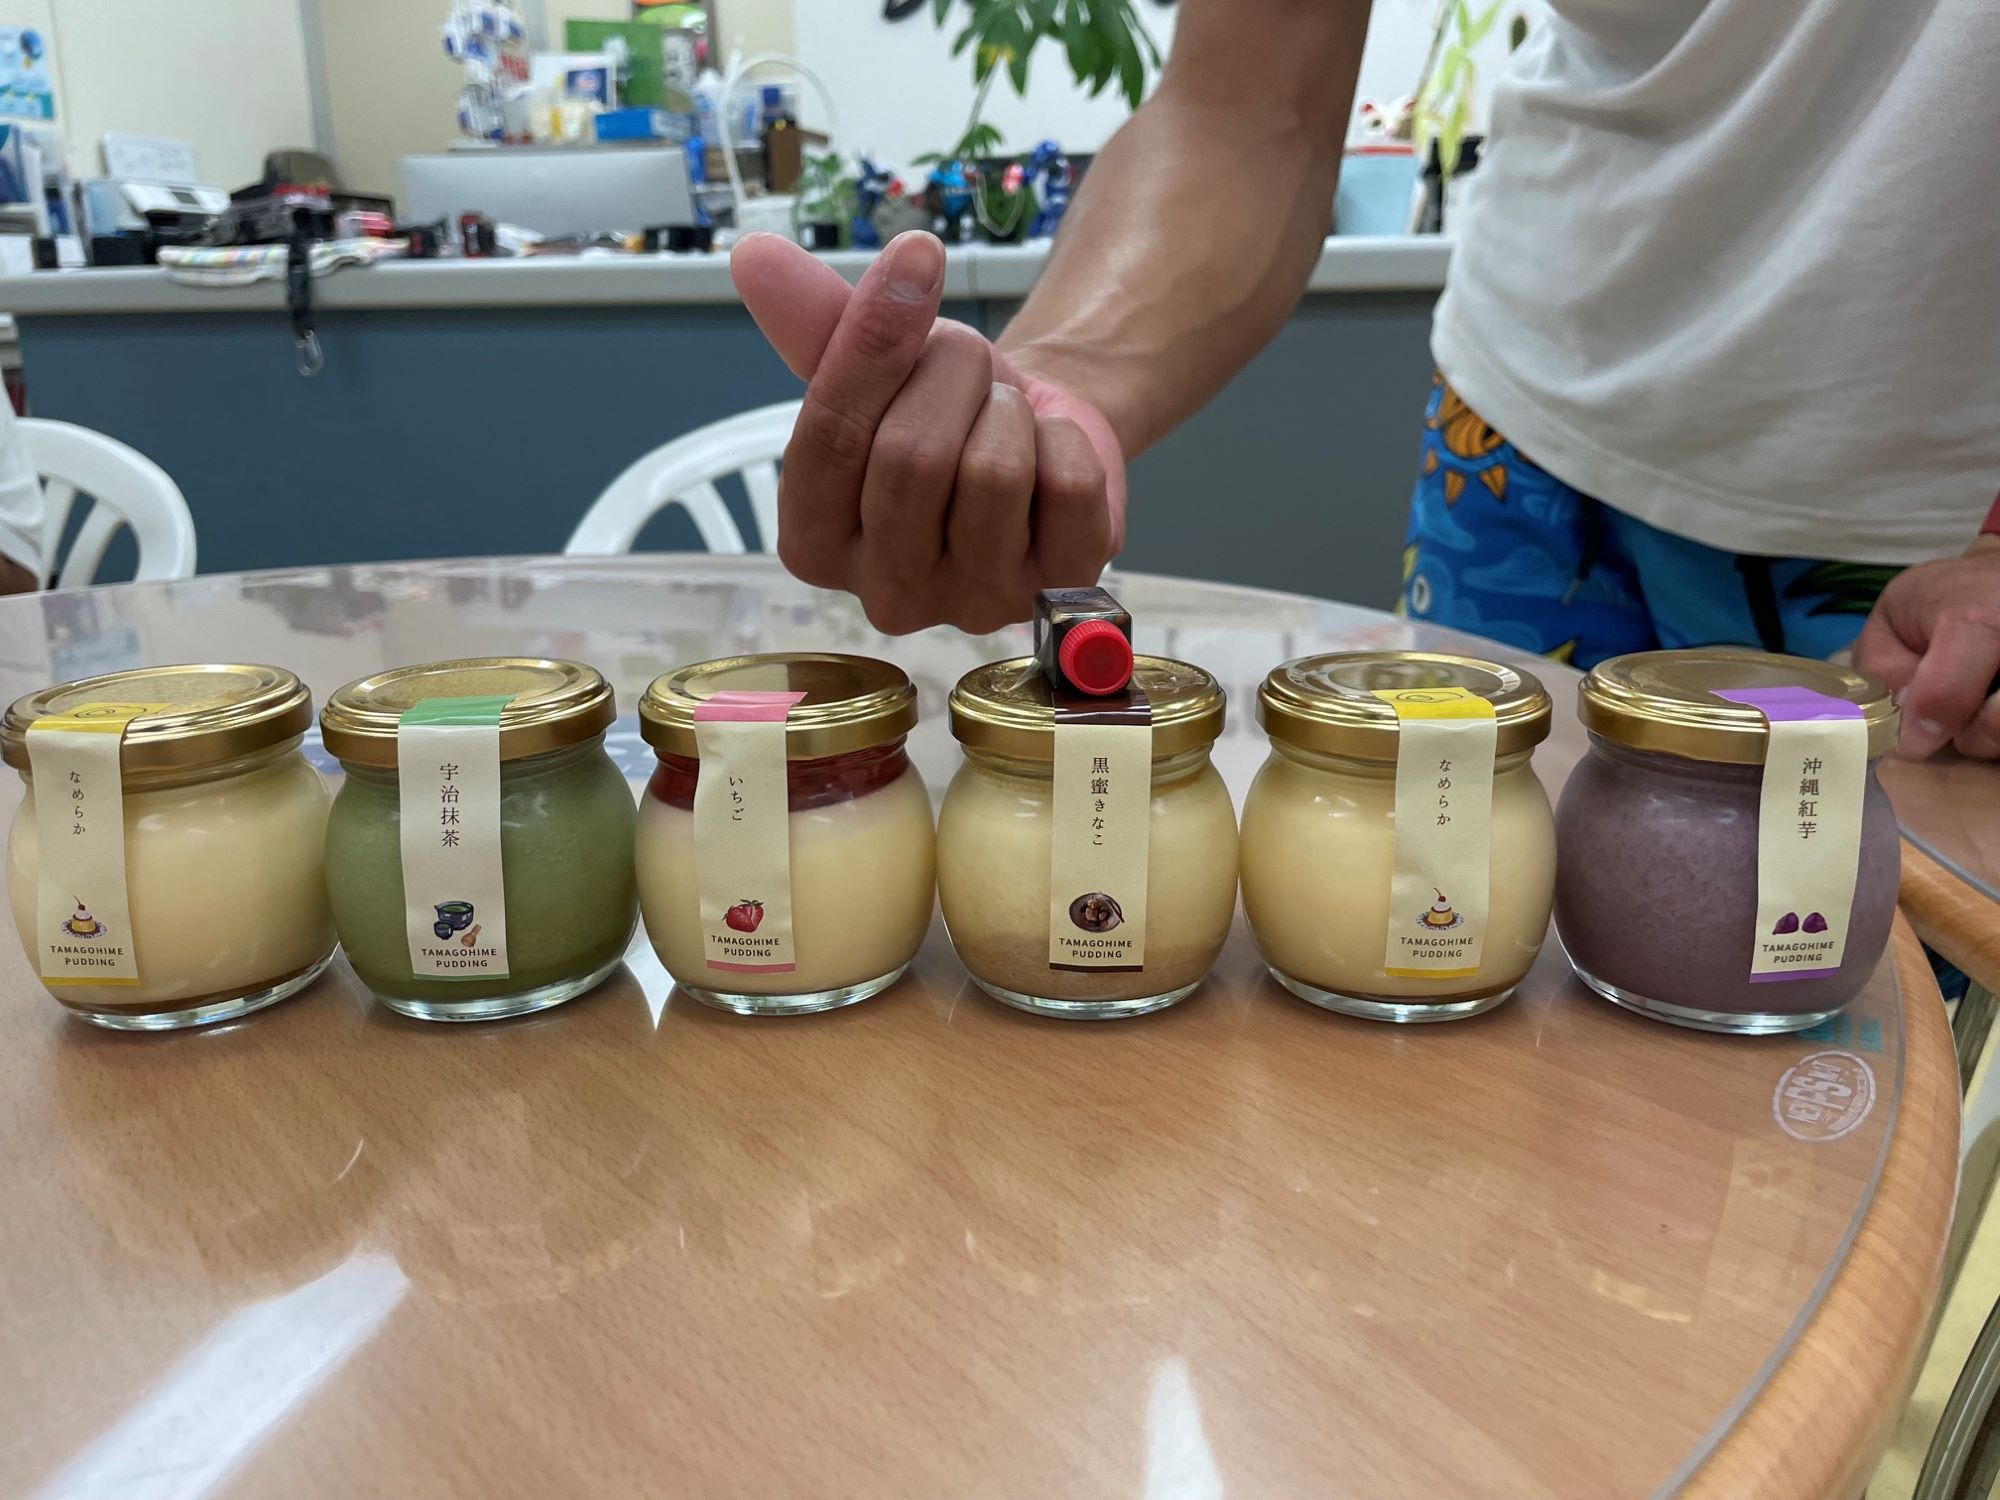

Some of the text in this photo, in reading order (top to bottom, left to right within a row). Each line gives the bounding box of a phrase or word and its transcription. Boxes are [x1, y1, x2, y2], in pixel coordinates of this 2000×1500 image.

[1436, 759, 1452, 826] なめらか
[70, 770, 86, 836] なめらか
[729, 776, 745, 821] いちご
[1091, 757, 1110, 846] 黒蜜きなこ
[1797, 757, 1823, 840] 沖縄紅芋
[440, 762, 460, 848] 宇治抹茶
[712, 935, 780, 946] TAMAGOHIME
[1058, 937, 1133, 948] TAMAGOHIME
[1401, 937, 1474, 947] TAMAGOHIME
[50, 945, 125, 956] TAMAGOHIME
[724, 947, 772, 957] PUDDING
[1762, 941, 1835, 952] TAMAGOHIME
[421, 948, 498, 957] TAMAGOHIME
[1072, 950, 1123, 959] PUDDING
[1412, 949, 1463, 958] PUDDING
[65, 957, 115, 967] PUDDING
[436, 959, 488, 968] PUDDING
[1772, 953, 1823, 964] PUDDING
